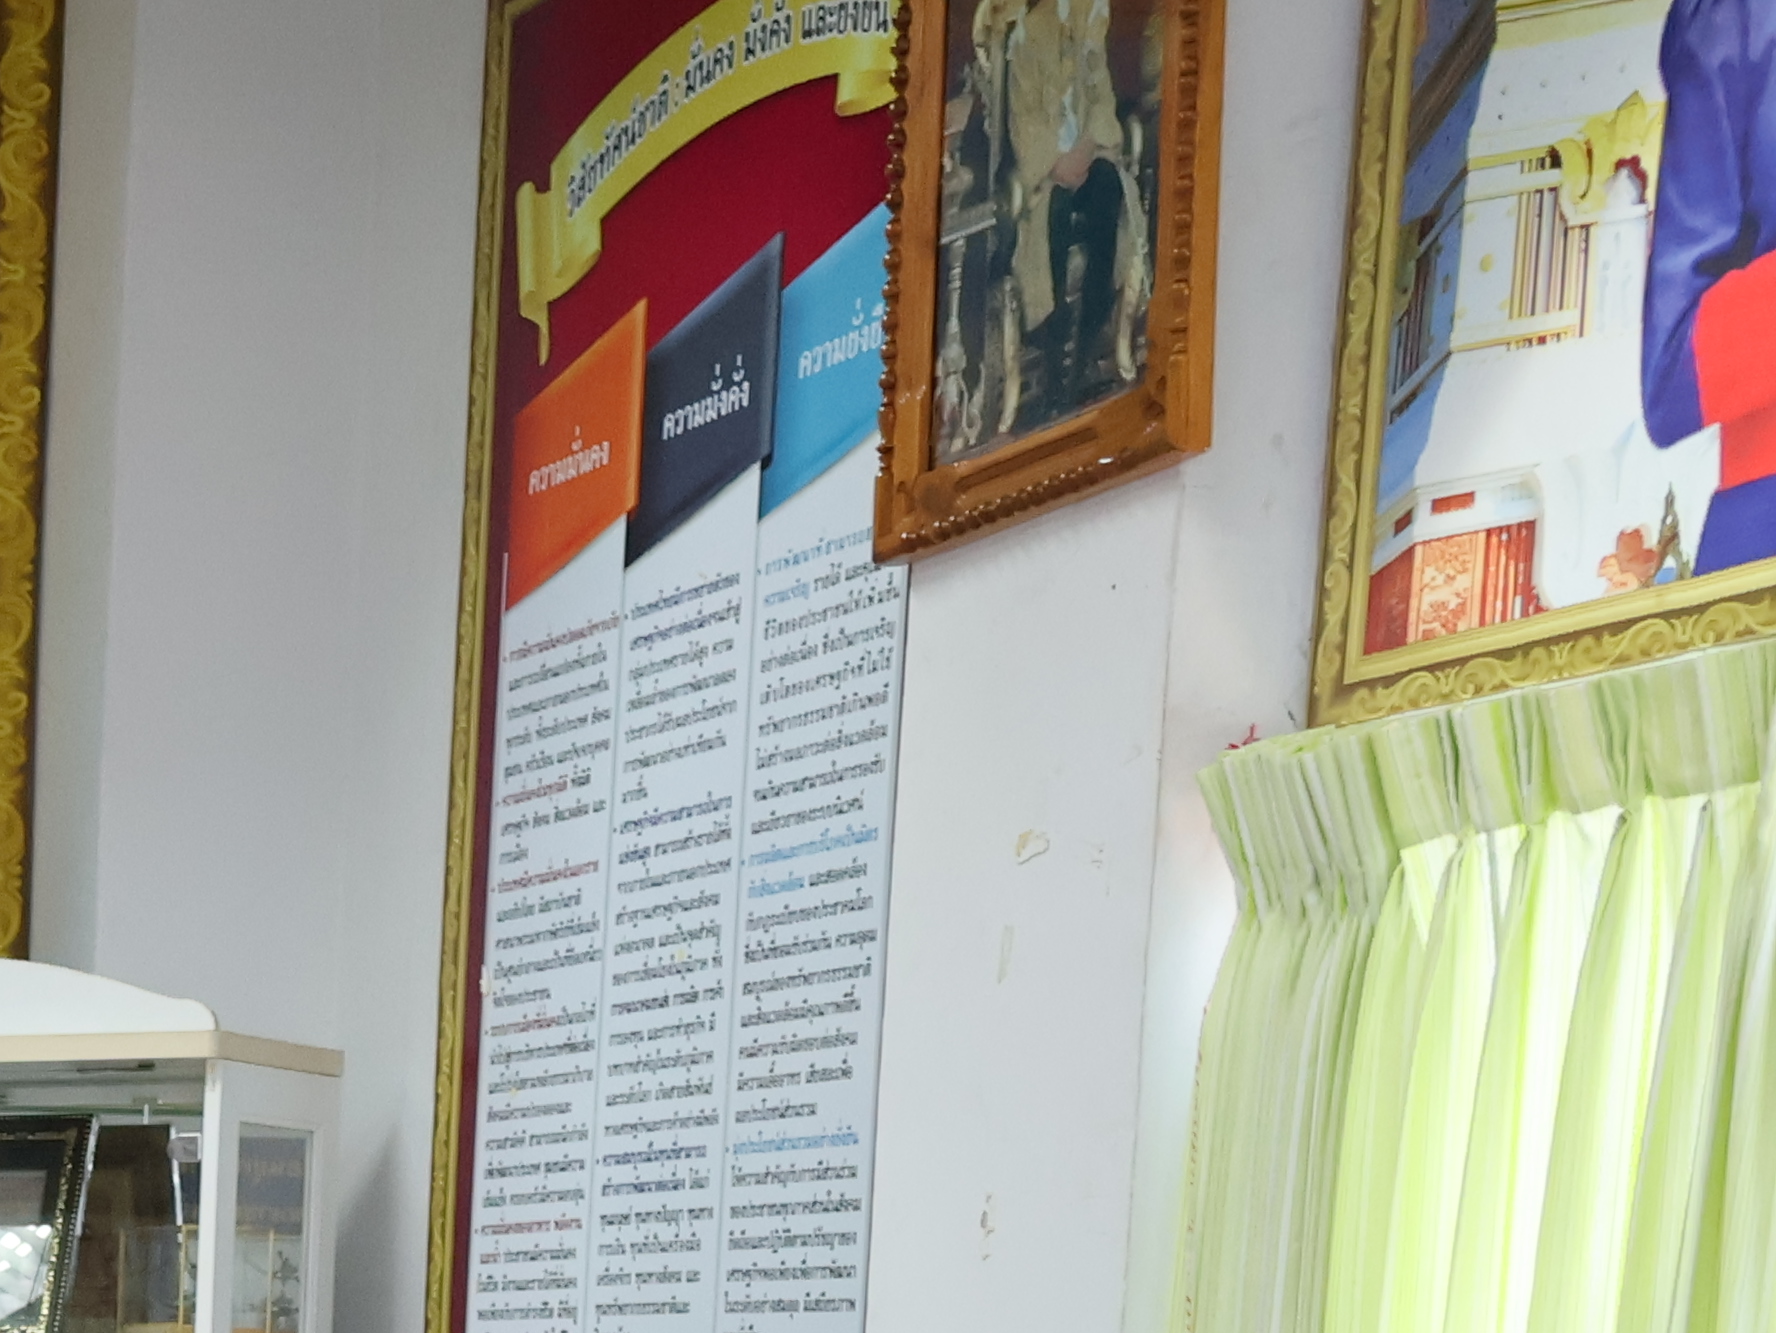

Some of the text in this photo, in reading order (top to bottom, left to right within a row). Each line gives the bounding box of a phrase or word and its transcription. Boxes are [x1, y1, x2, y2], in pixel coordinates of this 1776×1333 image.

[684, 26, 735, 100] มั่นคง
[662, 355, 750, 440] ความมั่งคั่ง
[528, 426, 610, 495] ความมั่นคง
